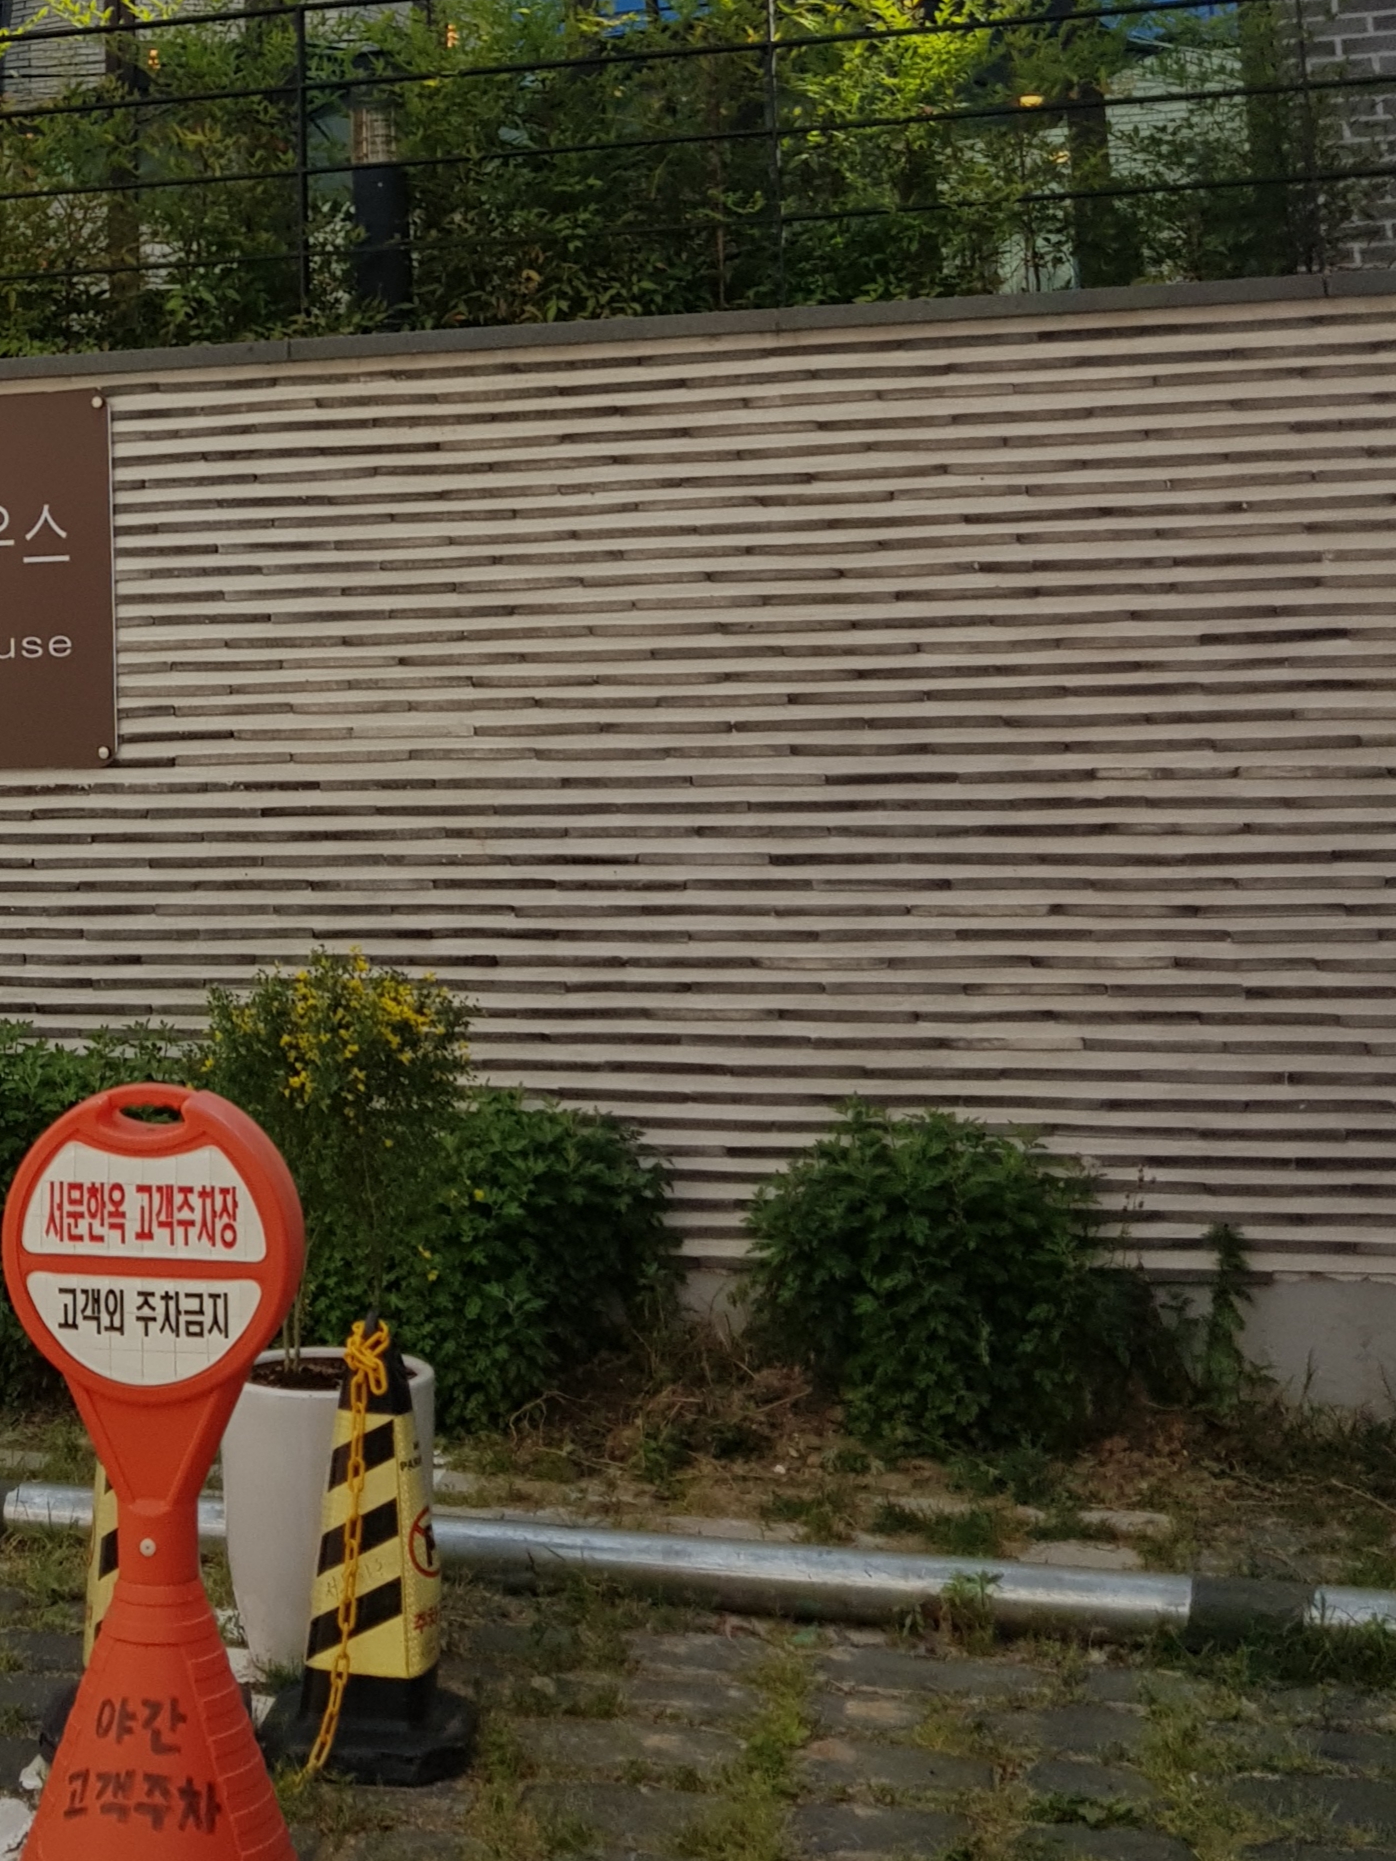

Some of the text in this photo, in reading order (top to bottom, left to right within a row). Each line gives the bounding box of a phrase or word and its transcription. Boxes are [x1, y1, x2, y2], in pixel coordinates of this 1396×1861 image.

[45, 1180, 239, 1250] 서문한옥 고객주차장
[57, 1287, 230, 1339] 고객외 주차금지
[96, 1696, 188, 1756] 야간
[63, 1768, 223, 1835] 고객주차
